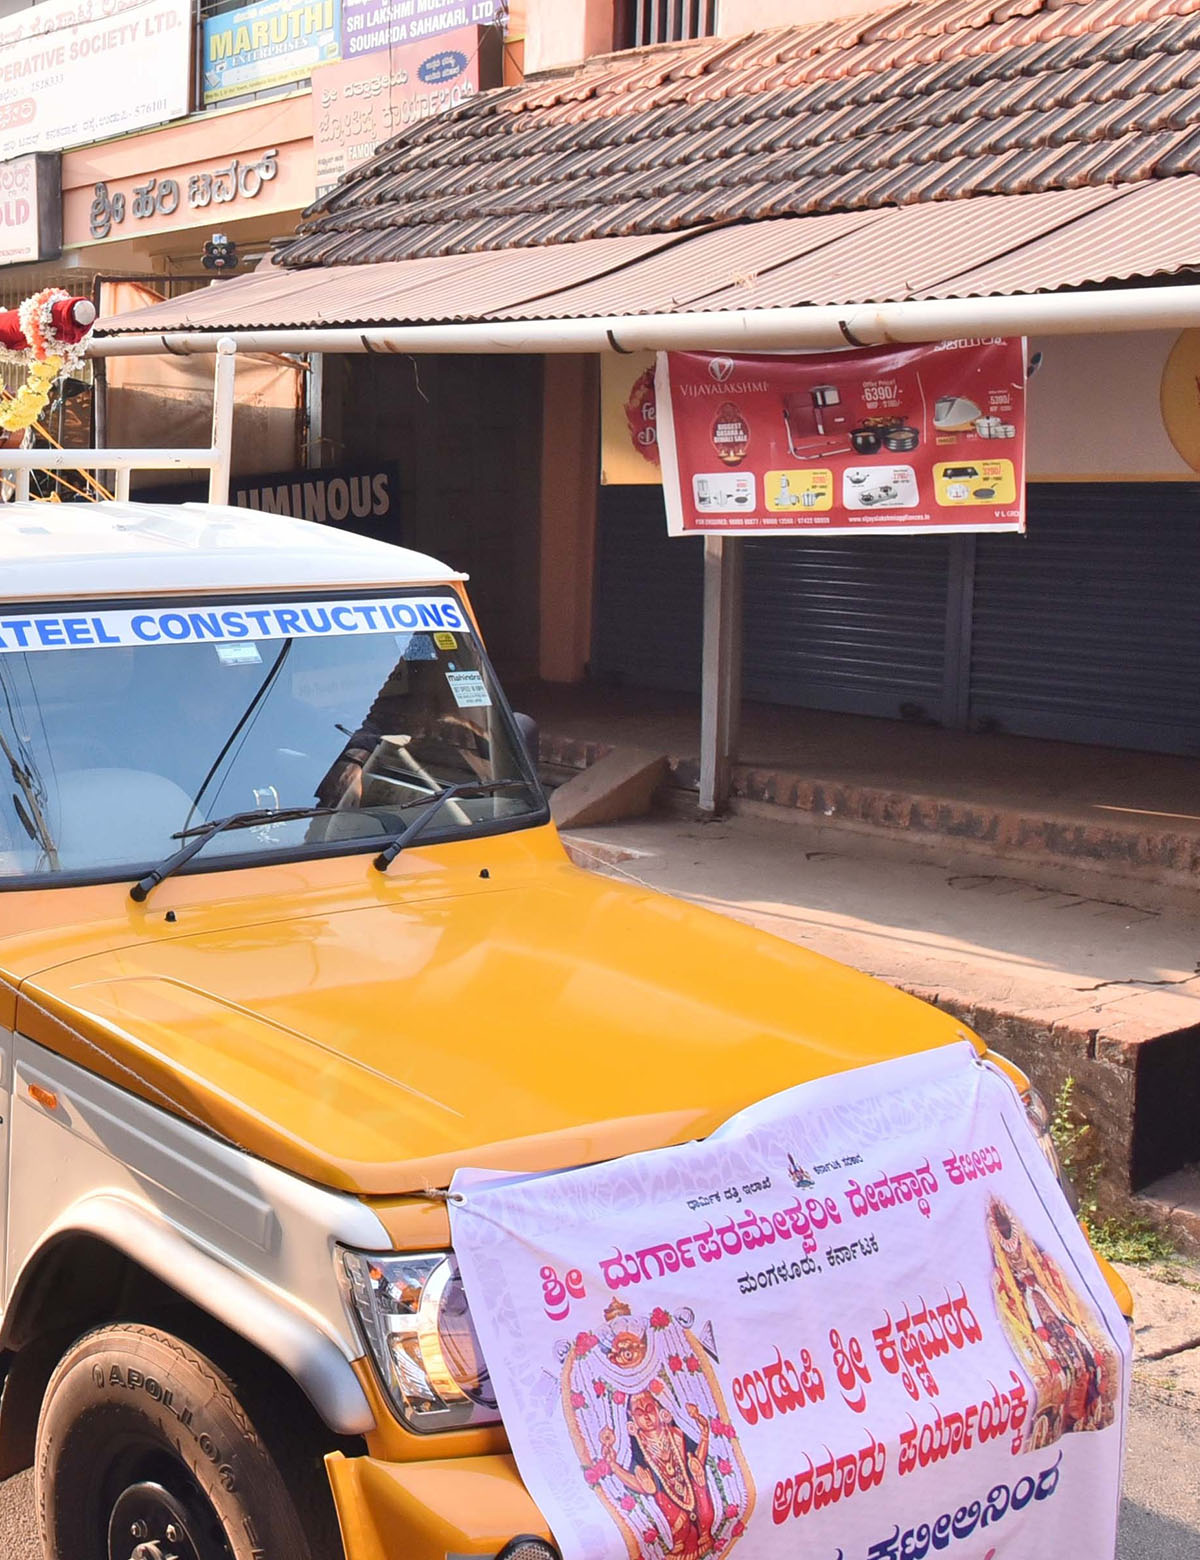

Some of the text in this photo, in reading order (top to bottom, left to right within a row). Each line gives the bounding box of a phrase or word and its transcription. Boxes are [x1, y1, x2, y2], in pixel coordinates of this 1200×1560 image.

[69, 22, 140, 61] SOCIETY
[144, 10, 182, 37] LTD.
[209, 0, 334, 61] MARUTHI
[346, 14, 364, 32] SRI
[366, 3, 415, 28] LAKSHMI
[349, 26, 407, 53] SOUHARDA
[409, 8, 469, 37] SAHAKARI,
[232, 38, 308, 66] ENTERPRISES
[90, 149, 279, 240] ಶ್ರೀ ಹರಿ ಟವರ್
[679, 381, 769, 398] VIJAYALAKSHMI
[236, 474, 390, 523] MINOUS
[129, 602, 463, 643] CONSTRUCTIONS
[687, 1191, 722, 1211] ಧಾರ್ಮಿಕ
[742, 1176, 772, 1196] ಇಲಾಖೆ
[539, 1144, 1004, 1321] ಶ್ರೀ ದುರ್ಗಾಪರಮೇಶ್ವರೀ ದೇವಸ್ಥಾನ ಕಟೀಲು
[737, 1234, 880, 1296] ಮಂಗಳೂರು, ಕರ್ನಾಟಕ
[732, 1281, 983, 1426] ಉಡುಪಿ ಶ್ರೀ ಕೃಷ್ಣಮಠದ
[108, 1363, 220, 1465] APOLLO
[771, 1369, 1029, 1525] ಅದಮಾರು ಪರ್ಯಾಯಕ್ಕೆ
[867, 1449, 1063, 1560] ಕಟೀಲಿನಿಂದ
